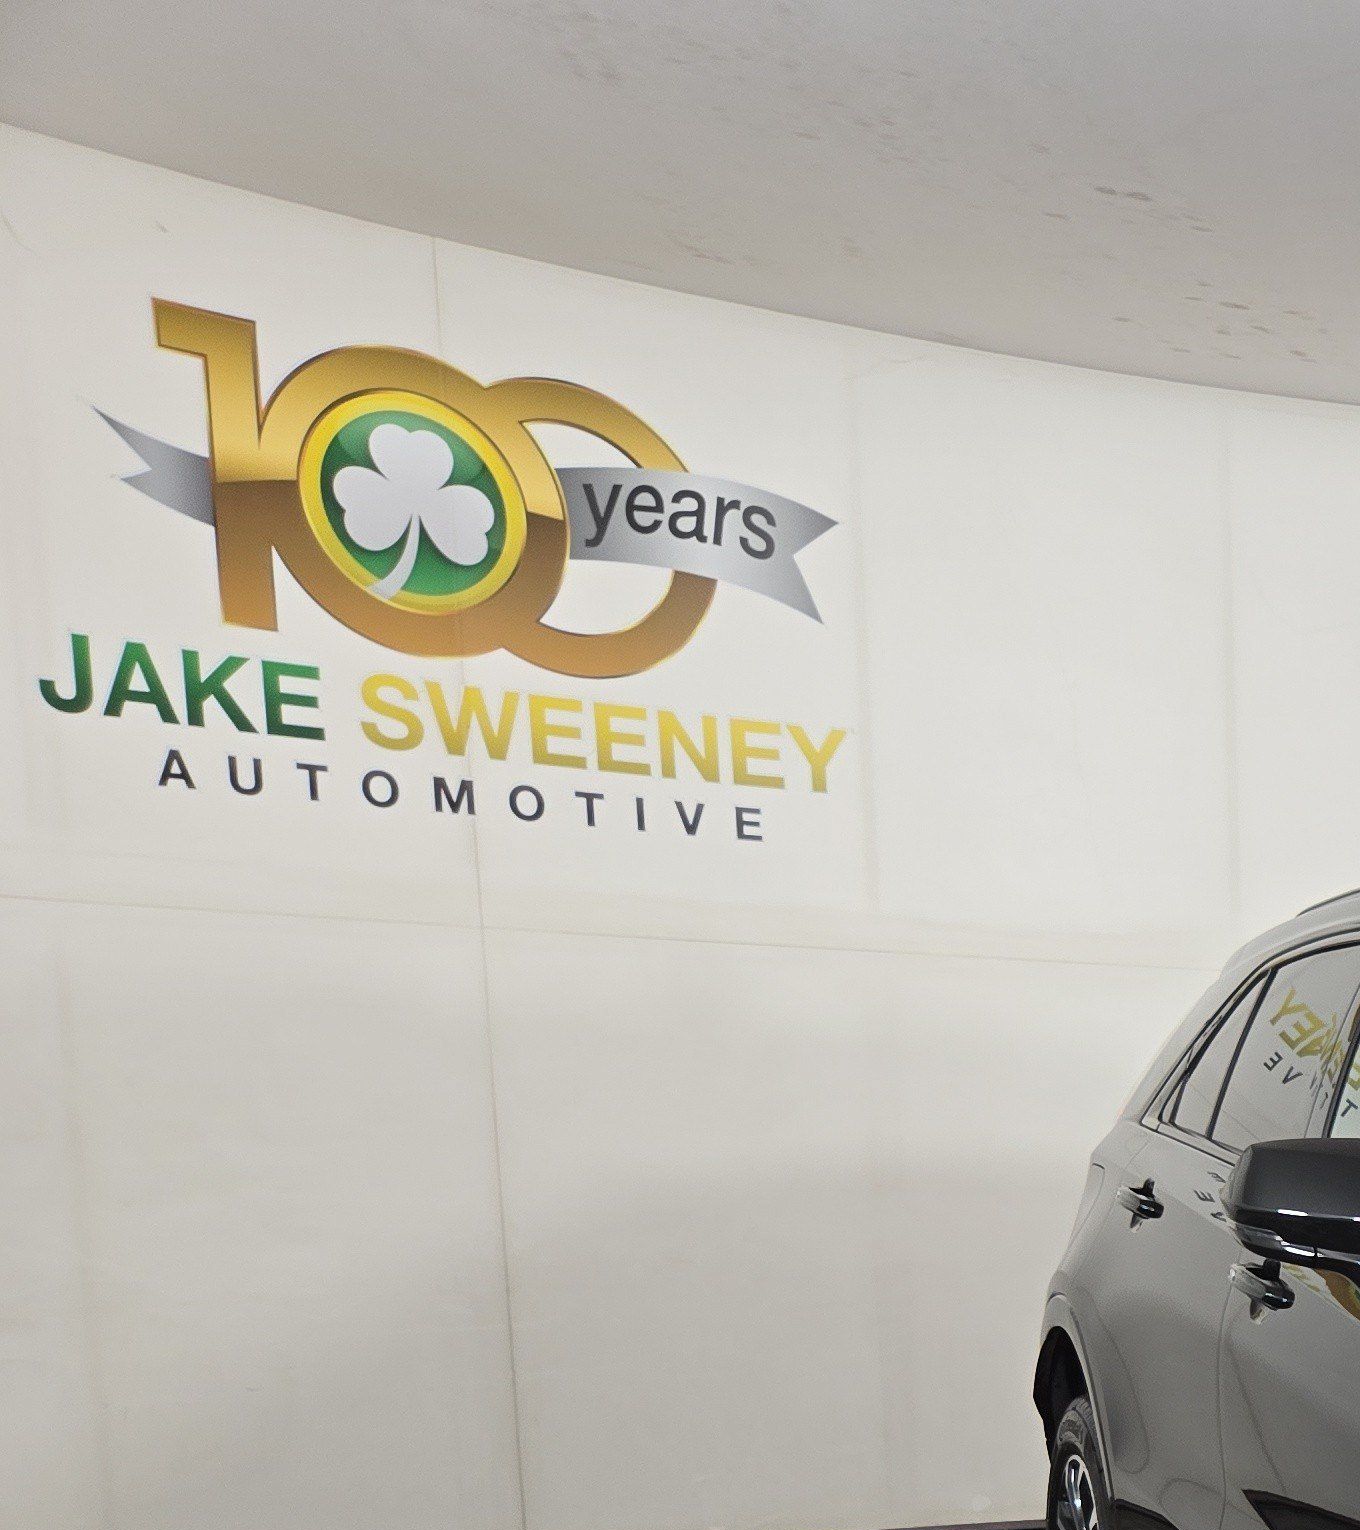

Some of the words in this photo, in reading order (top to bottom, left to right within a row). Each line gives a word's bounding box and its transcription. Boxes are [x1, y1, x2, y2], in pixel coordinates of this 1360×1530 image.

[151, 297, 718, 679] 100
[583, 479, 777, 561] years
[38, 633, 327, 742] JAKE
[360, 673, 847, 794] SWEENEY
[159, 749, 764, 842] AUTOMOTIVE
